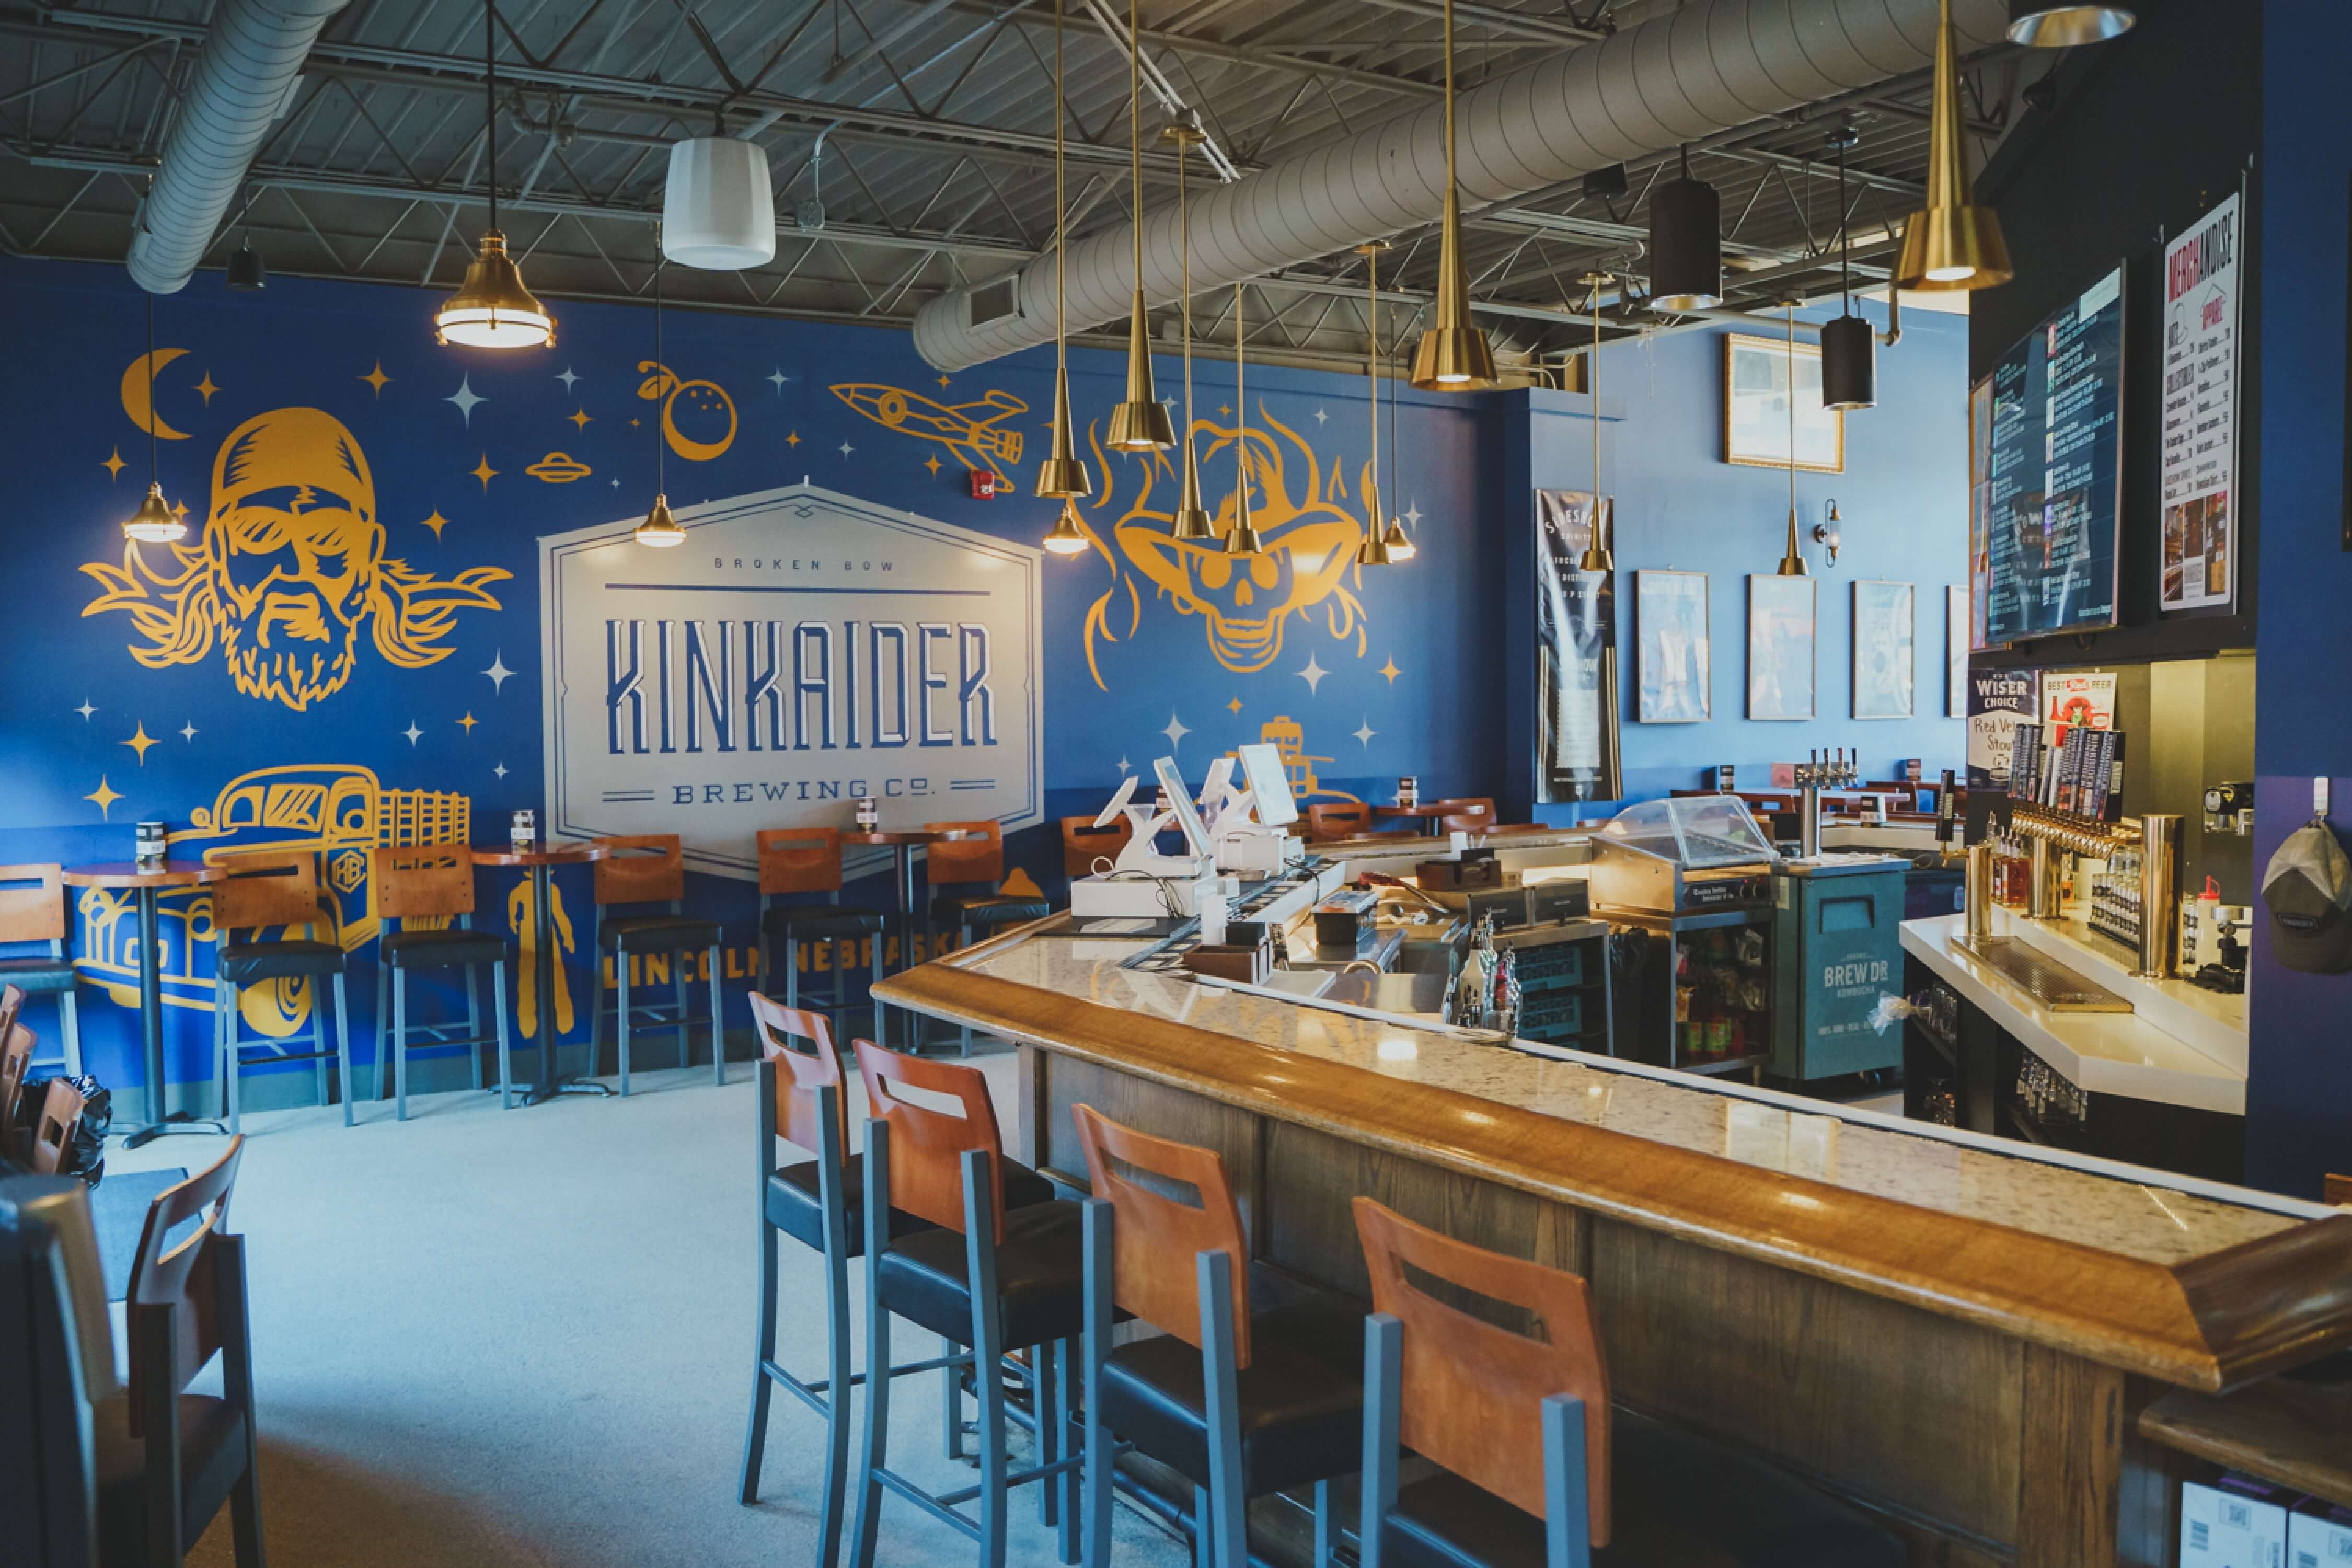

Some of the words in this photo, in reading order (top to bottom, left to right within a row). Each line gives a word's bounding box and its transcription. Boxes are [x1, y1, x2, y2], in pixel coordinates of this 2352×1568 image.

[2168, 210, 2233, 303] MERCHANDISE
[714, 557, 821, 571] BROKEN
[844, 560, 893, 572] BOW
[605, 619, 998, 755] KINKAIDER
[1975, 679, 2028, 695] WISER
[2047, 681, 2065, 690] BEST
[1985, 697, 2019, 709] CHOICE
[1974, 718, 1995, 733] Red
[1999, 718, 2015, 733] Vel
[1988, 734, 2013, 750] Stou
[672, 779, 868, 805] BREWING
[1824, 962, 1868, 987] BREW
